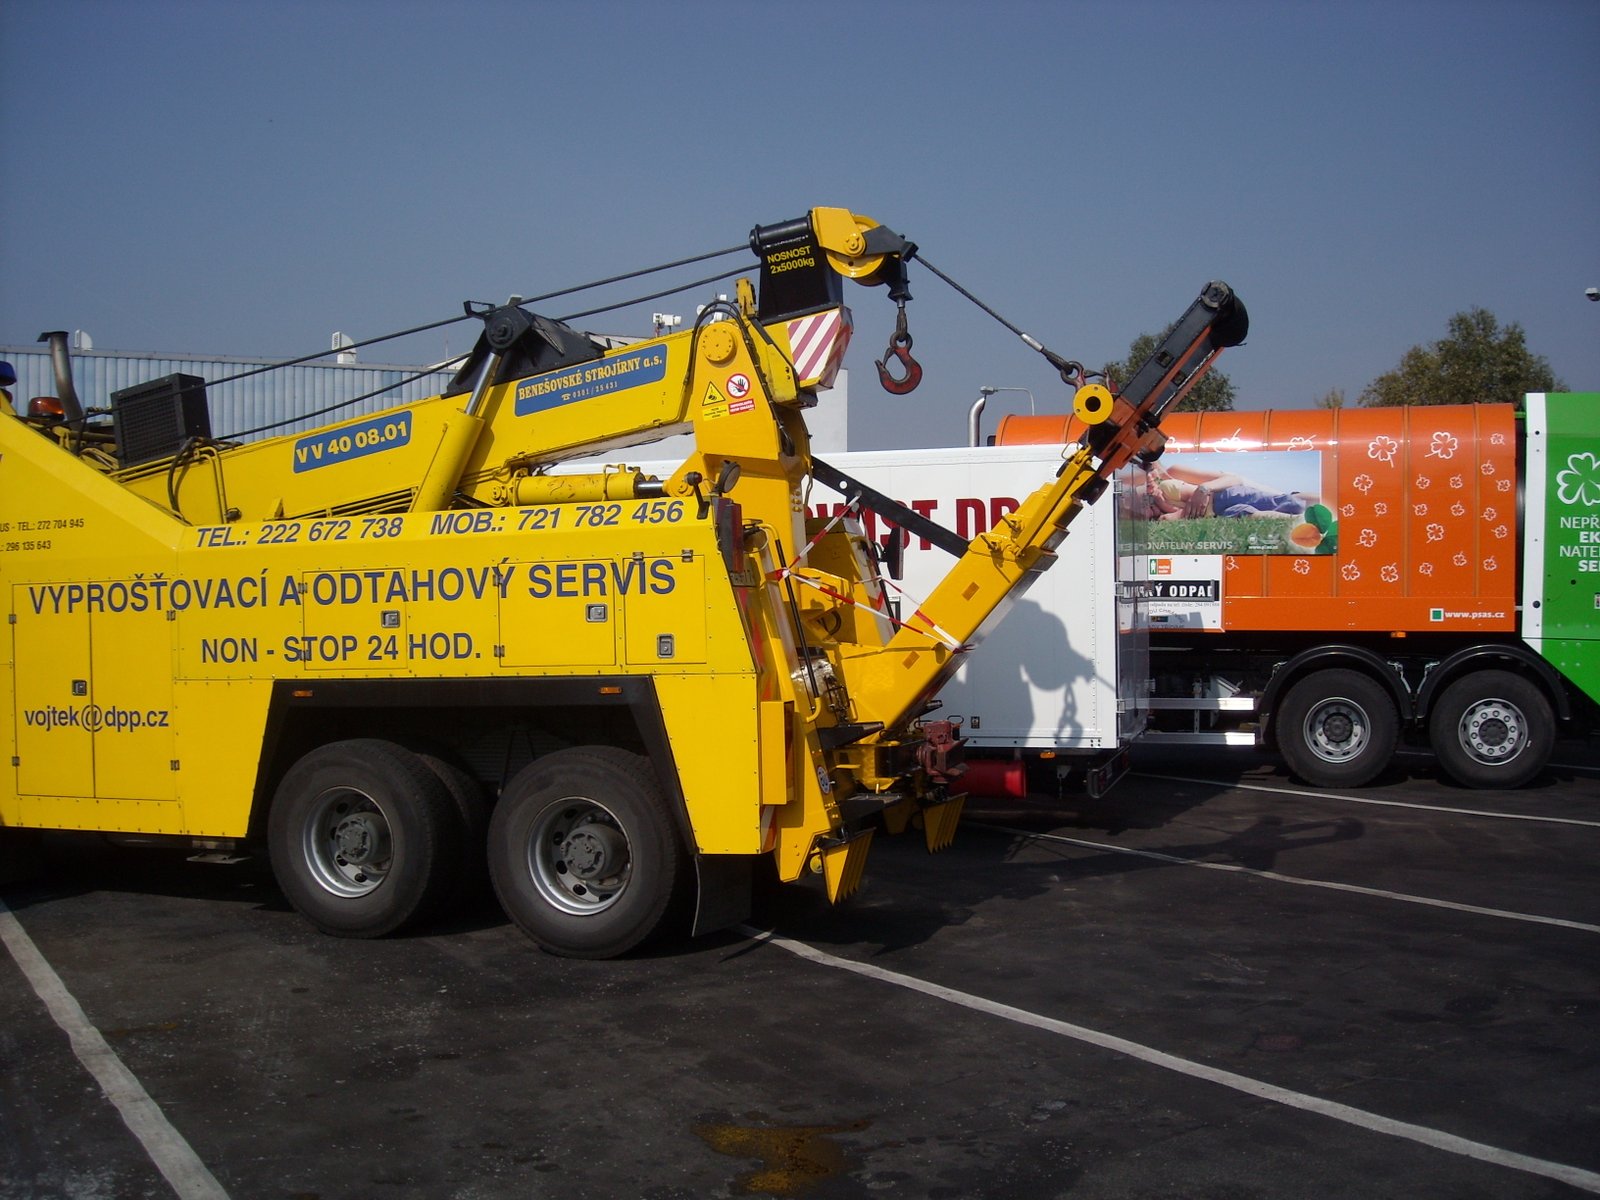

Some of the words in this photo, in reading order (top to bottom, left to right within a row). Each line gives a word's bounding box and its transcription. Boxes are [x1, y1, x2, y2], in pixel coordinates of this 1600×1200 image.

[767, 246, 811, 263] NOSNOST
[770, 258, 815, 274] 2x5000kg
[518, 370, 583, 400] BENEŠOVSKÉ
[585, 359, 641, 383] STROJÍRNY
[328, 436, 351, 455] 40
[355, 421, 407, 449] 08.01
[37, 520, 51, 530] 272
[197, 527, 250, 548] TEL.:
[257, 522, 301, 545] 222
[308, 519, 351, 542] 672
[359, 515, 404, 539] 738
[430, 511, 506, 536] MOB.:
[516, 507, 562, 531] 721
[574, 504, 622, 528] 782
[632, 500, 684, 525] 456
[1196, 541, 1233, 550] SERVIS
[1560, 545, 1600, 557] NATE
[1578, 559, 1600, 572] SE
[29, 569, 268, 614] VYPROŠŤOVACÍ
[279, 575, 302, 607] A
[313, 558, 515, 606] ODTAHOVÝ
[528, 559, 676, 599] SERVIS
[202, 637, 258, 663] NON
[283, 635, 358, 662] STOP
[367, 634, 399, 661] 24
[409, 633, 481, 660] HOD.
[24, 704, 169, 732] vojtek@dpp.cz
